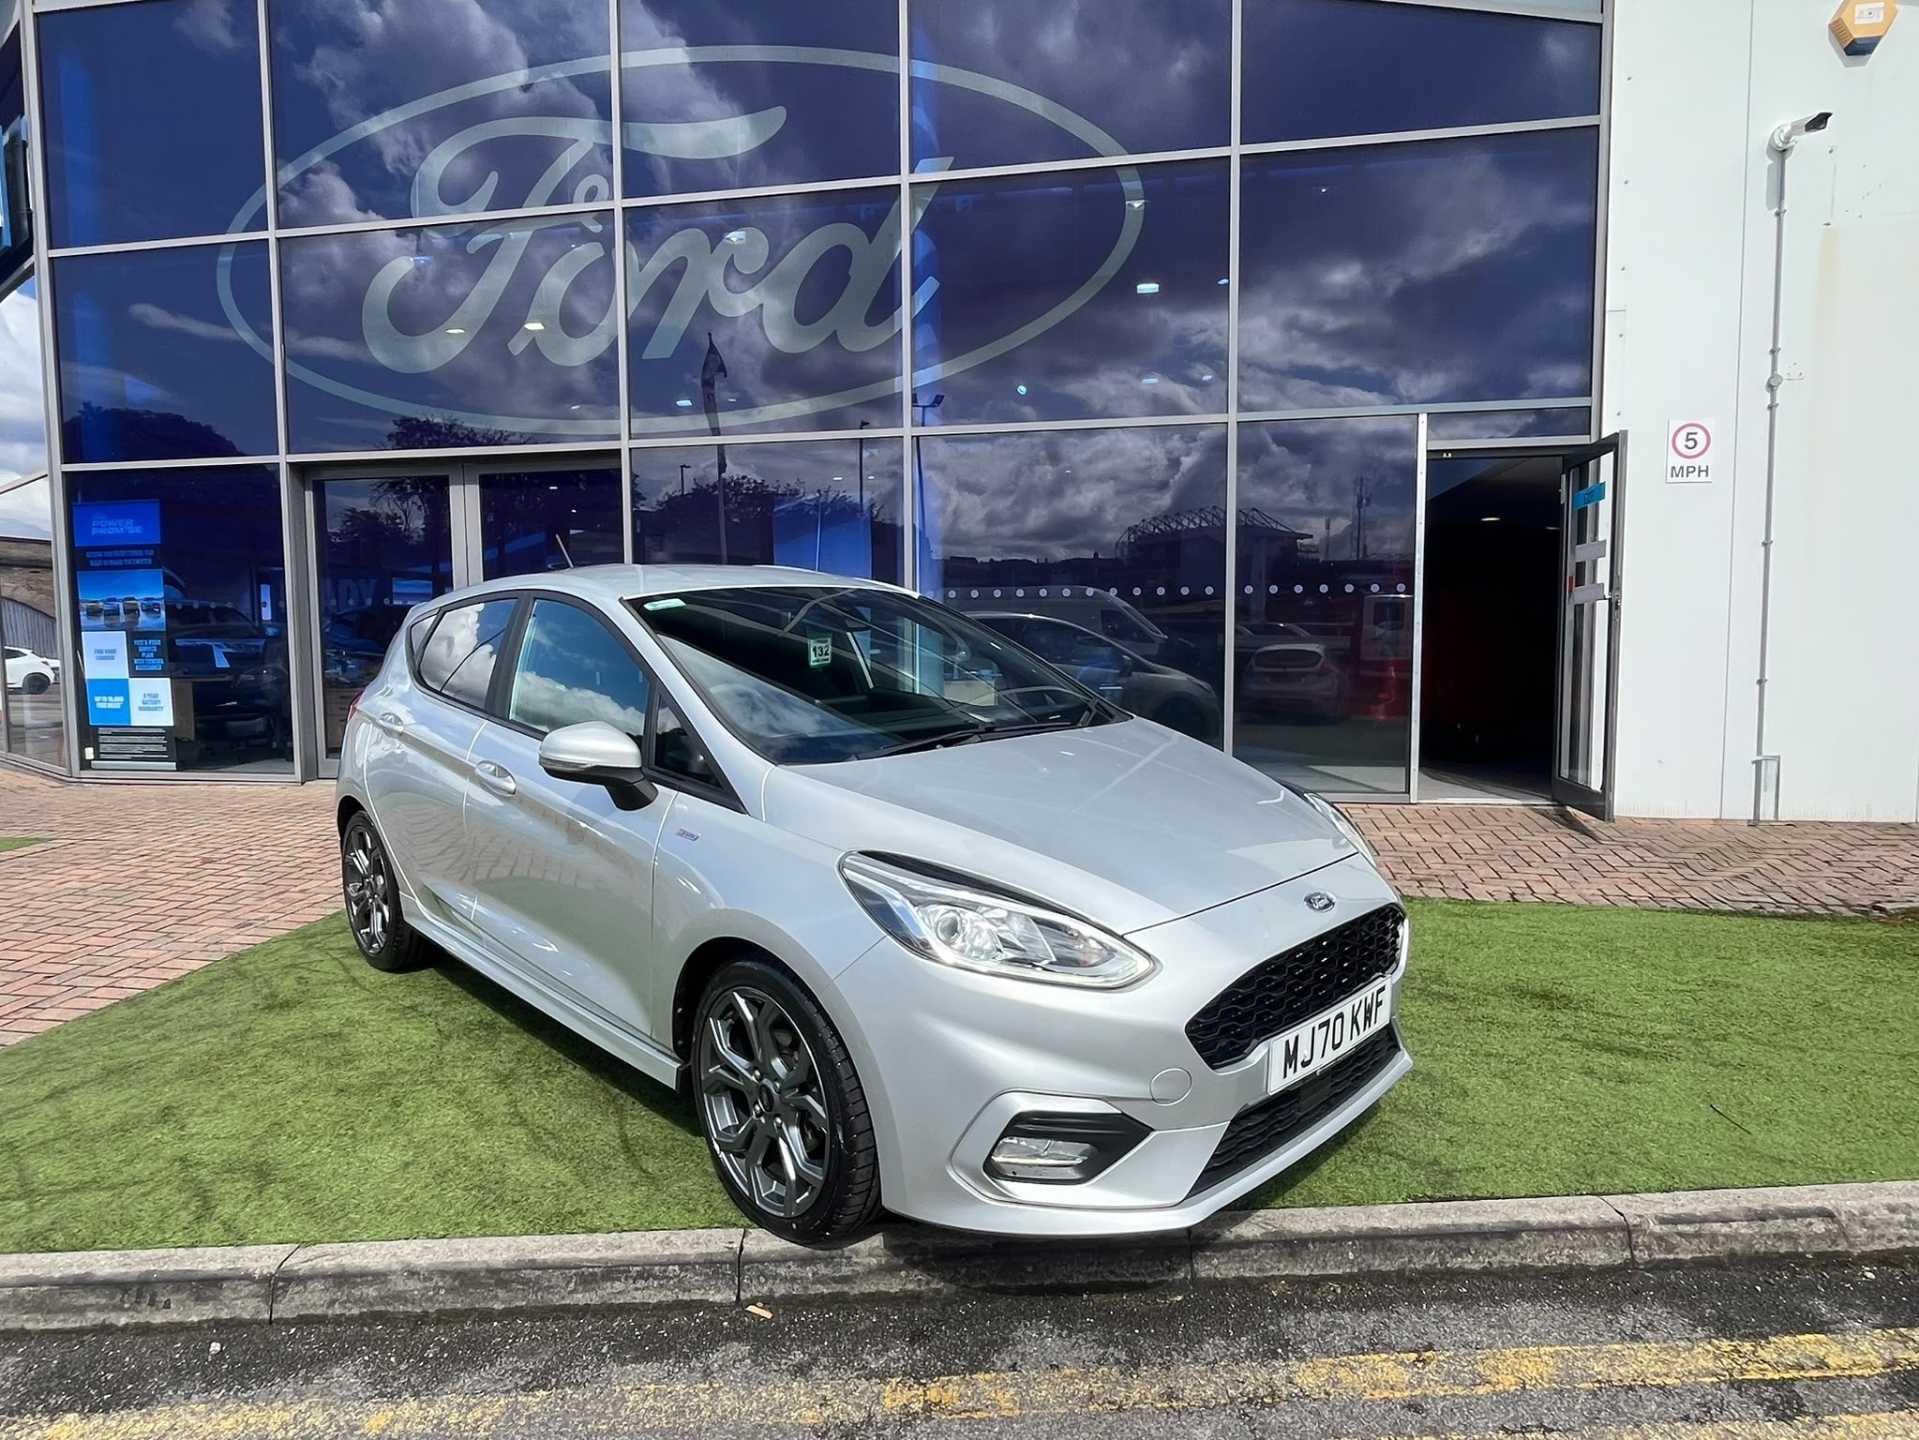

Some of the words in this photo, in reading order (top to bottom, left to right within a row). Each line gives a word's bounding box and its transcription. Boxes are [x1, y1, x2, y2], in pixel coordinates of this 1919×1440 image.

[362, 106, 955, 374] Ford
[1684, 431, 1698, 450] 5
[1670, 464, 1709, 478] MPH
[812, 644, 830, 658] 132
[1283, 1011, 1345, 1079] MJ70
[1349, 984, 1386, 1041] KWF
